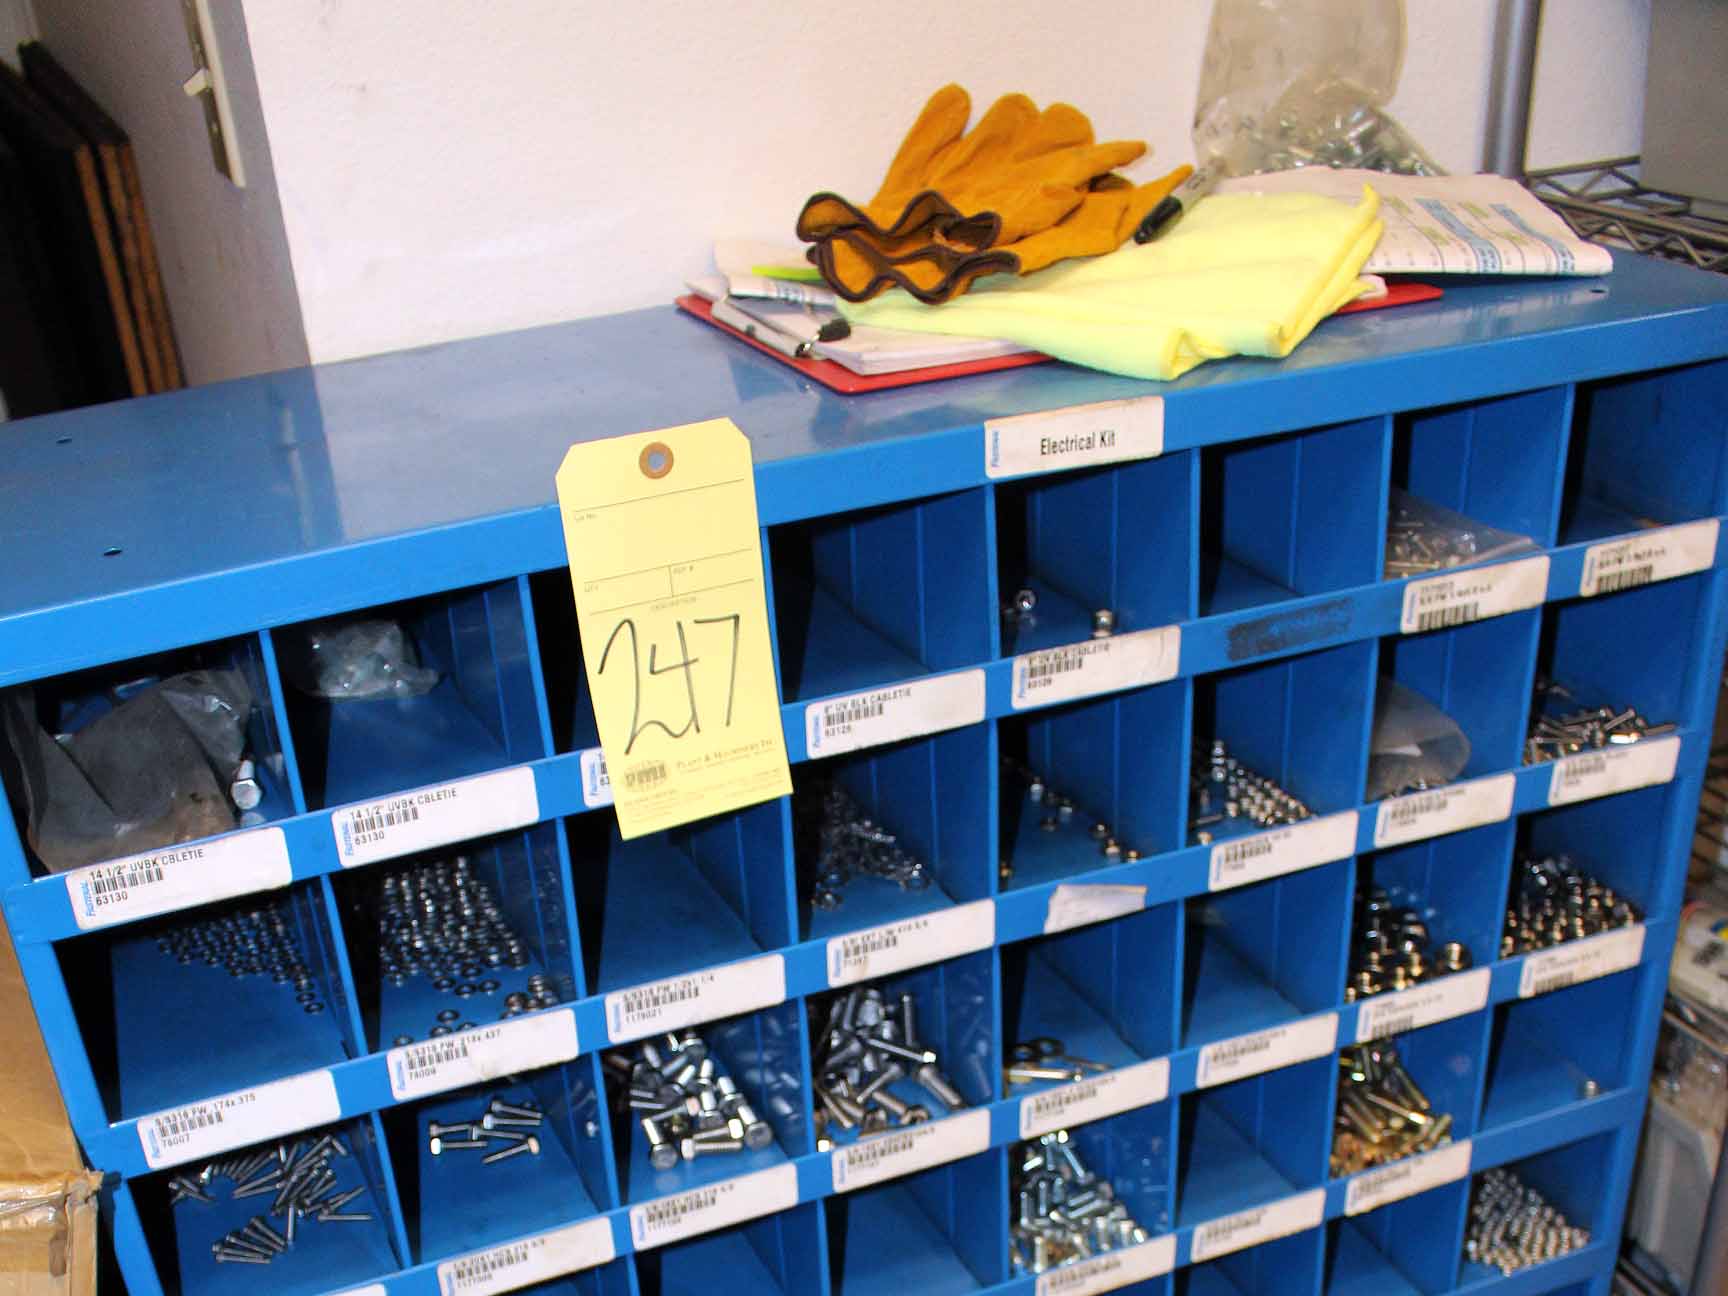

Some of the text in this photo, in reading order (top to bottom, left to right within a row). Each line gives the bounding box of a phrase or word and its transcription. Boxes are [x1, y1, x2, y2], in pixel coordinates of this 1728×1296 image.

[1040, 429, 1116, 456] Electrical Kit
[597, 612, 740, 756] 247
[350, 809, 363, 821] 14
[387, 798, 415, 814] UVBK
[417, 788, 457, 805] CBLETIE
[354, 831, 385, 847] 63130
[90, 869, 103, 881] 14
[129, 856, 159, 873] UVBK
[161, 848, 205, 867] CBLETIE
[96, 892, 128, 907] 63130
